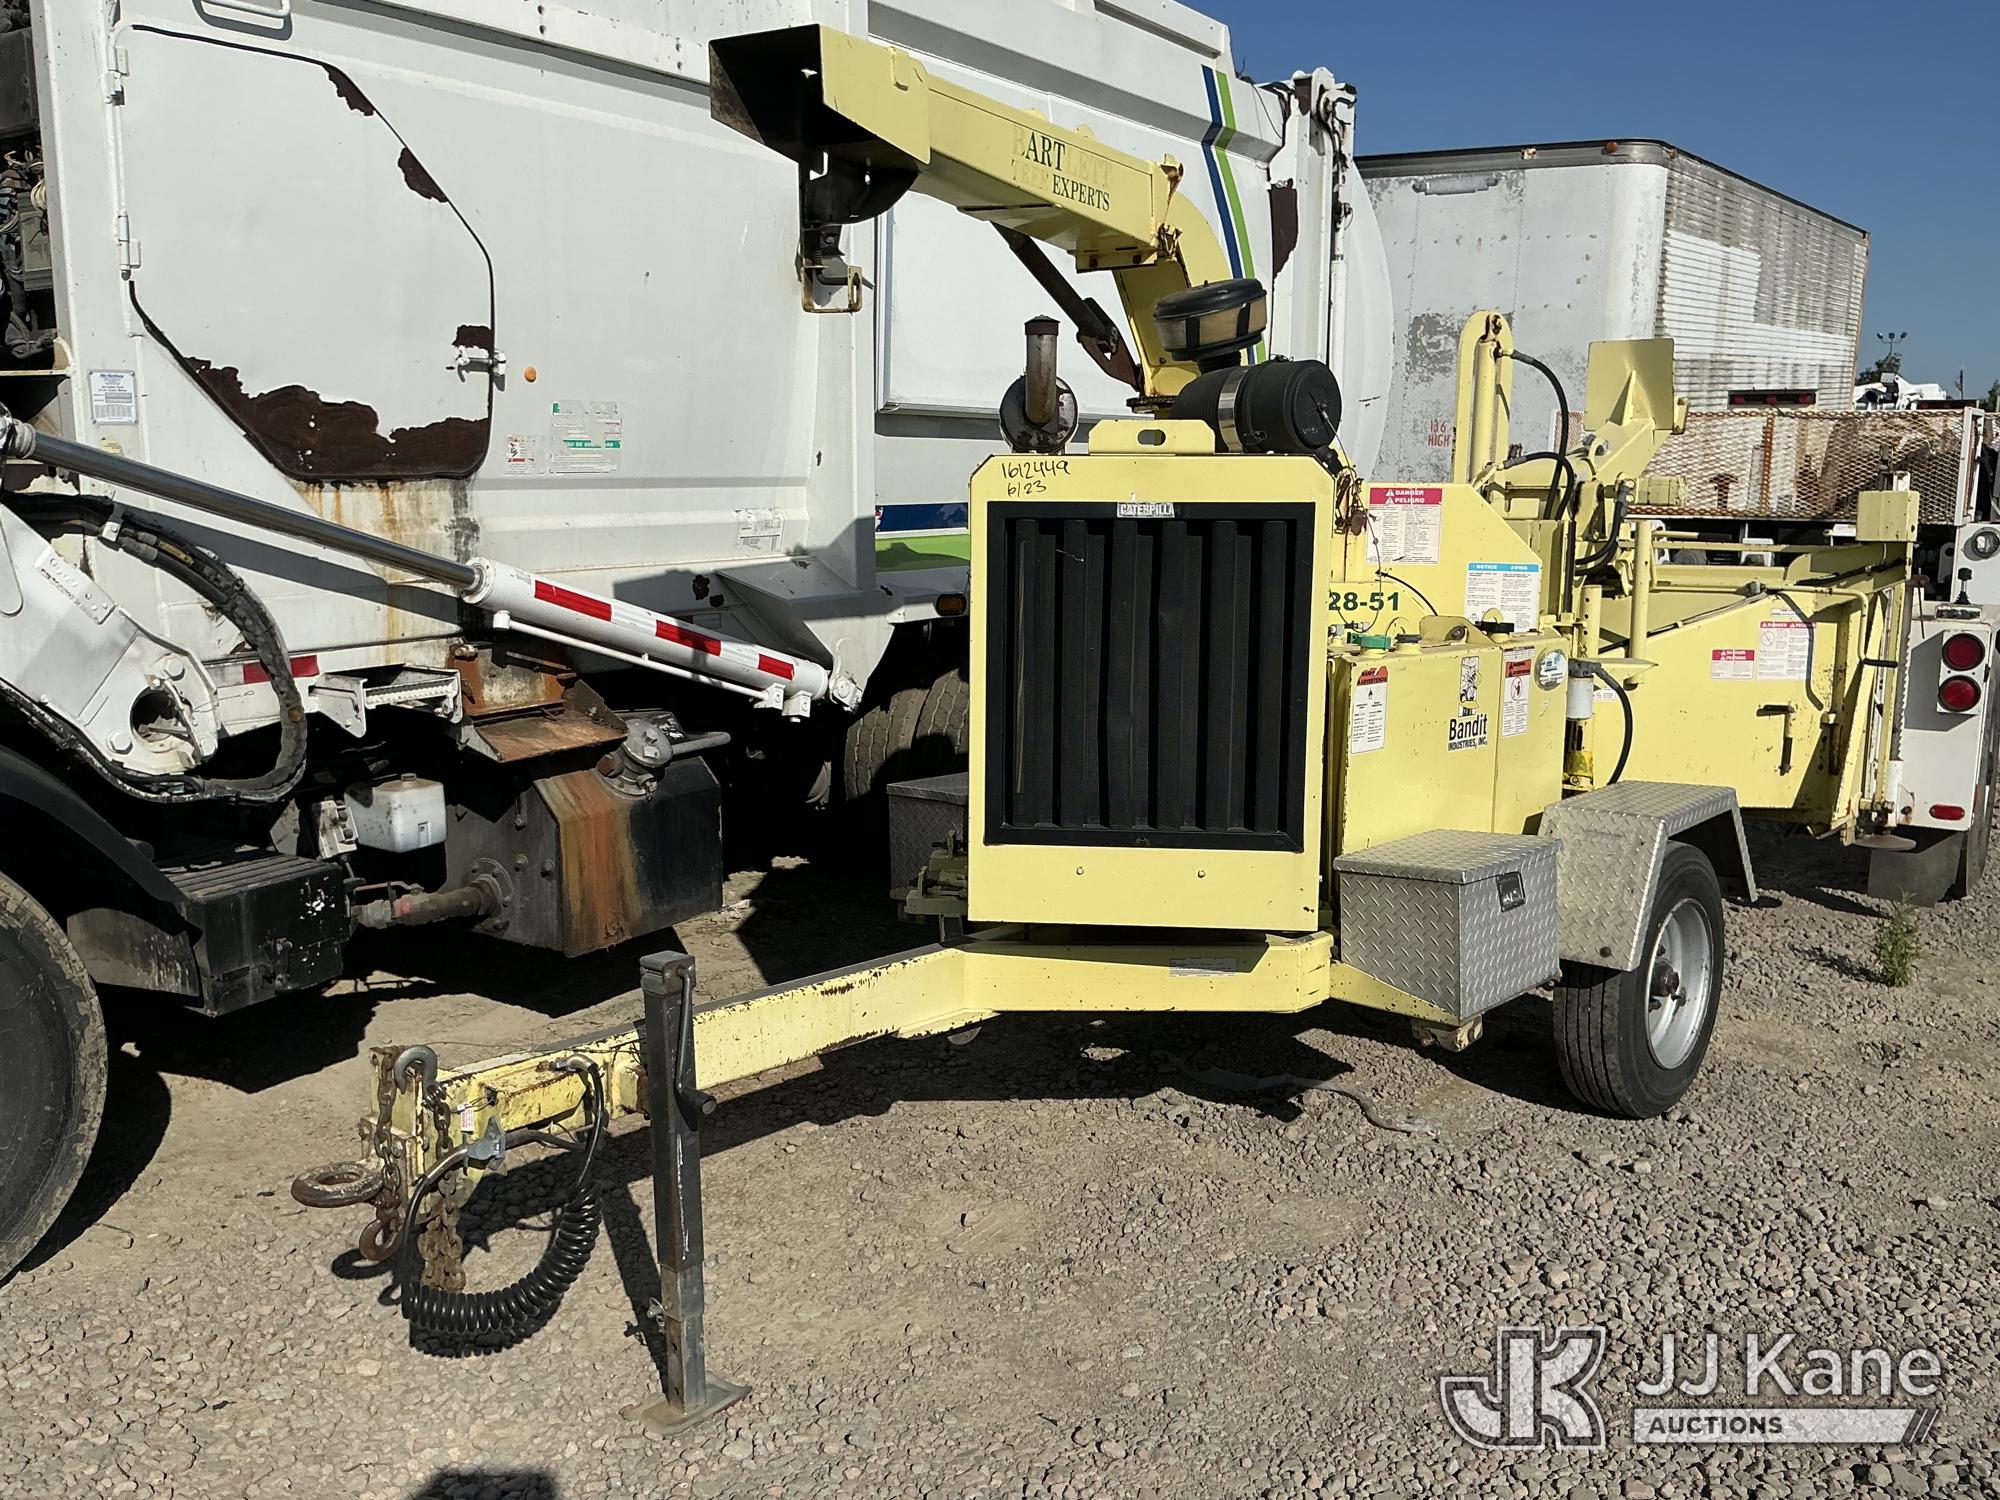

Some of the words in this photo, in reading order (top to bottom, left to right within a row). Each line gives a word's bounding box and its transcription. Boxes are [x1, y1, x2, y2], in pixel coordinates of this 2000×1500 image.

[1052, 173, 1111, 212] EXPERTS
[1427, 434, 1450, 447] HIGH
[1001, 459, 1071, 480] 1612449
[1007, 480, 1047, 497] 6/23
[1328, 591, 1400, 612] 28-51
[1449, 714, 1488, 741] Bandit
[1448, 739, 1477, 751] INDUSTRIES,
